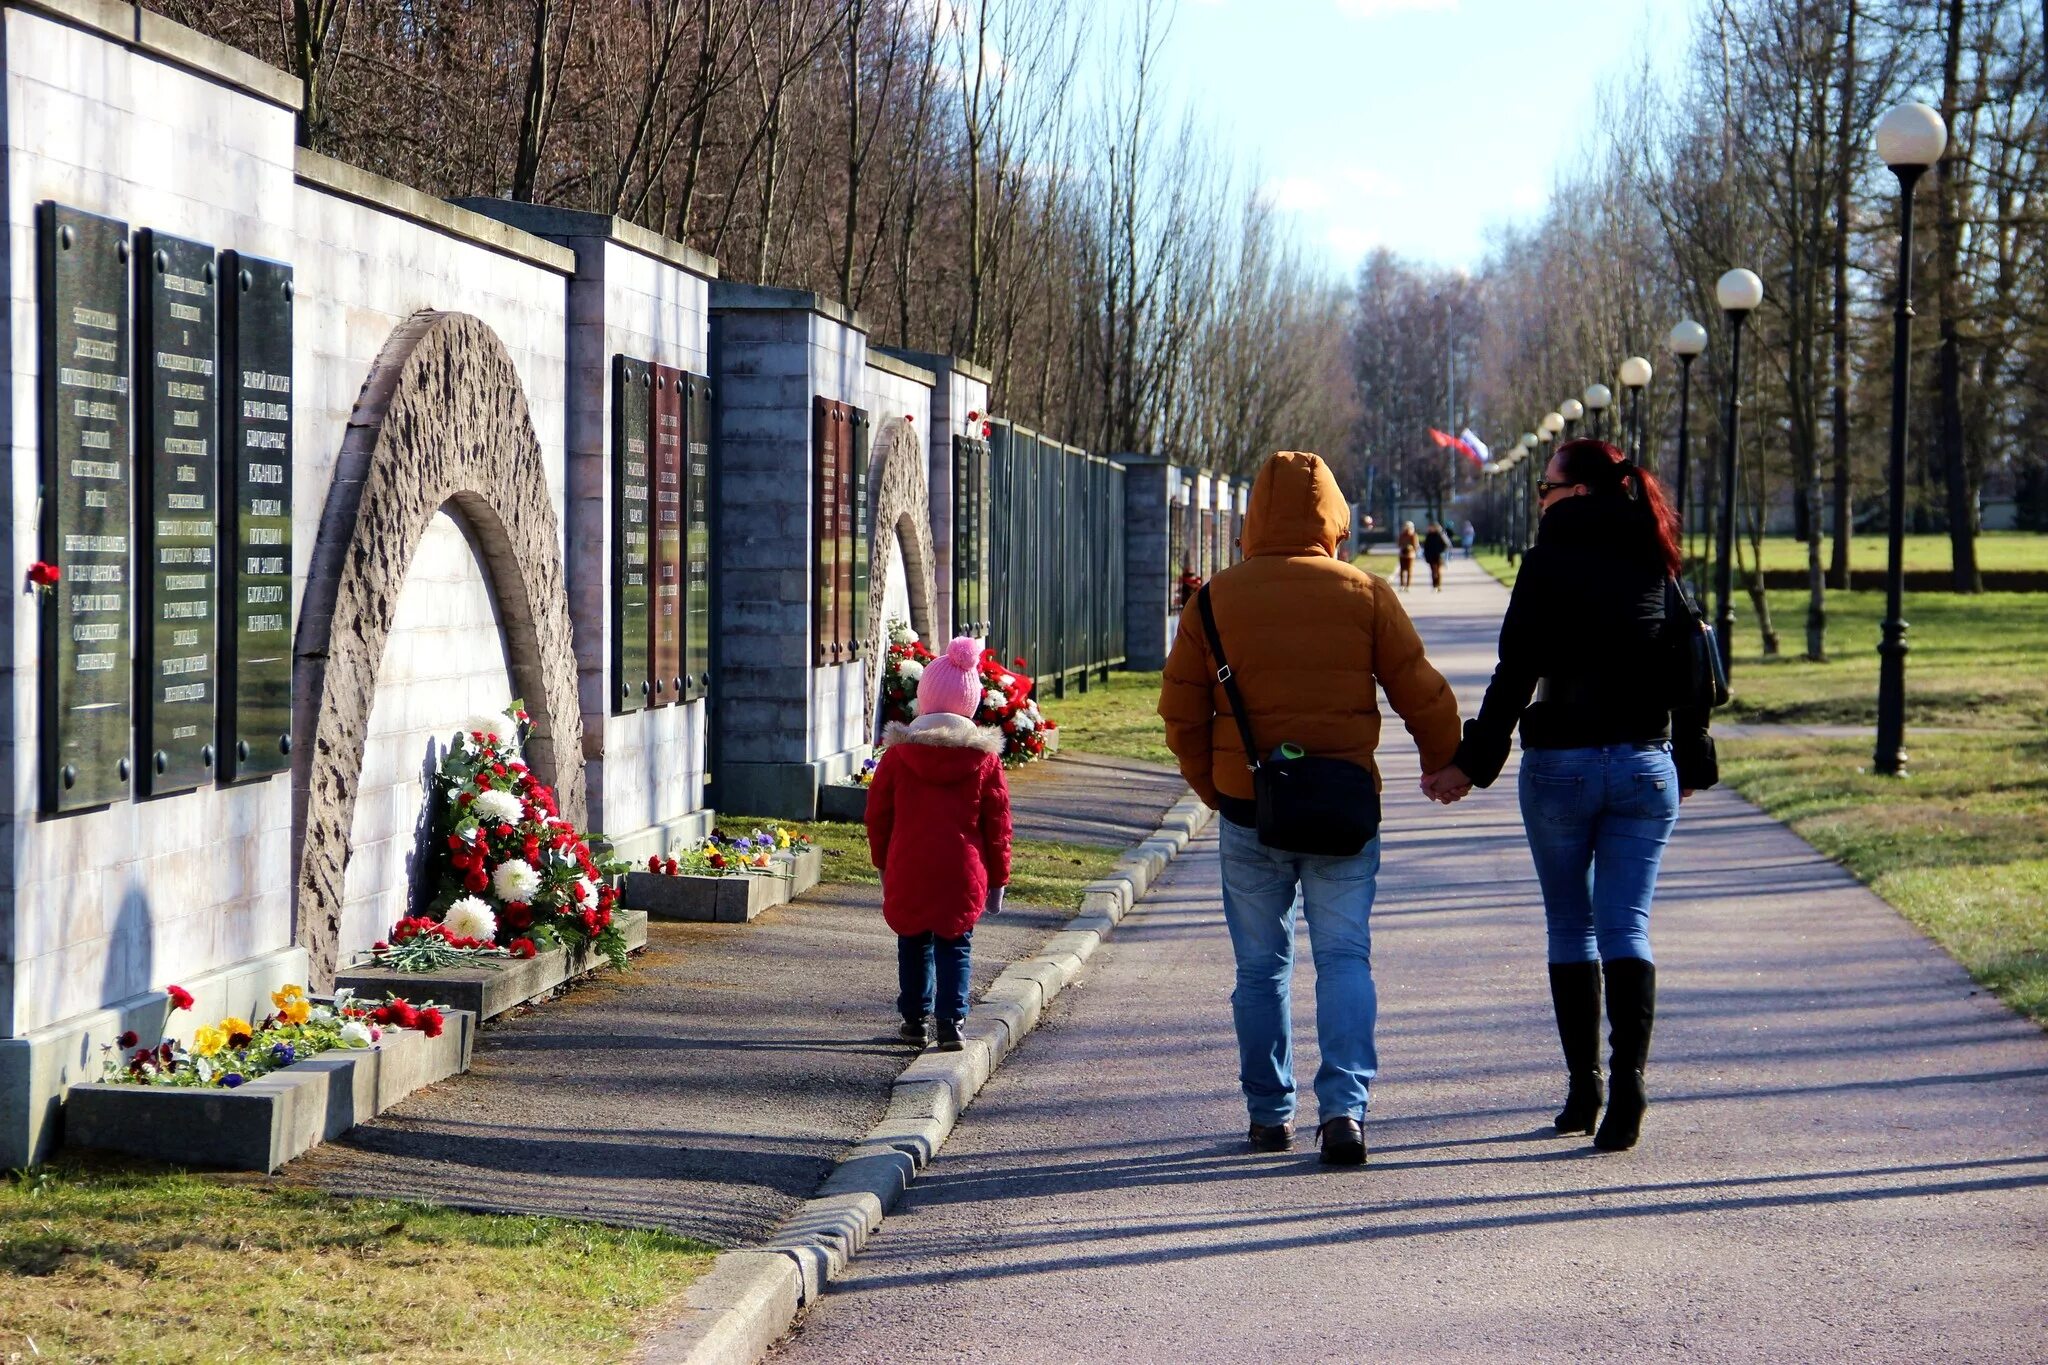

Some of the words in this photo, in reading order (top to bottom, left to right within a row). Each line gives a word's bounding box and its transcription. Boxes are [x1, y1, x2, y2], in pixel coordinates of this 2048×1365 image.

[243, 370, 266, 389] ЗЕМНОЙ
[267, 374, 290, 392] ПОКЛОН
[244, 400, 266, 418] ВЕЧНАЯ
[267, 402, 288, 421] ПАМЯТЬ
[246, 430, 286, 450] БЛАГОДАРНЫХ
[249, 463, 282, 485] КУБАНЦЕВ
[249, 528, 282, 544] ПОГИБШИМ
[247, 558, 260, 574] ПРИ
[261, 557, 283, 574] ЗАЩИТЕ
[248, 586, 282, 603] БЛОКАДНОГО
[248, 615, 282, 632] ЛЕНИНГРАДА
